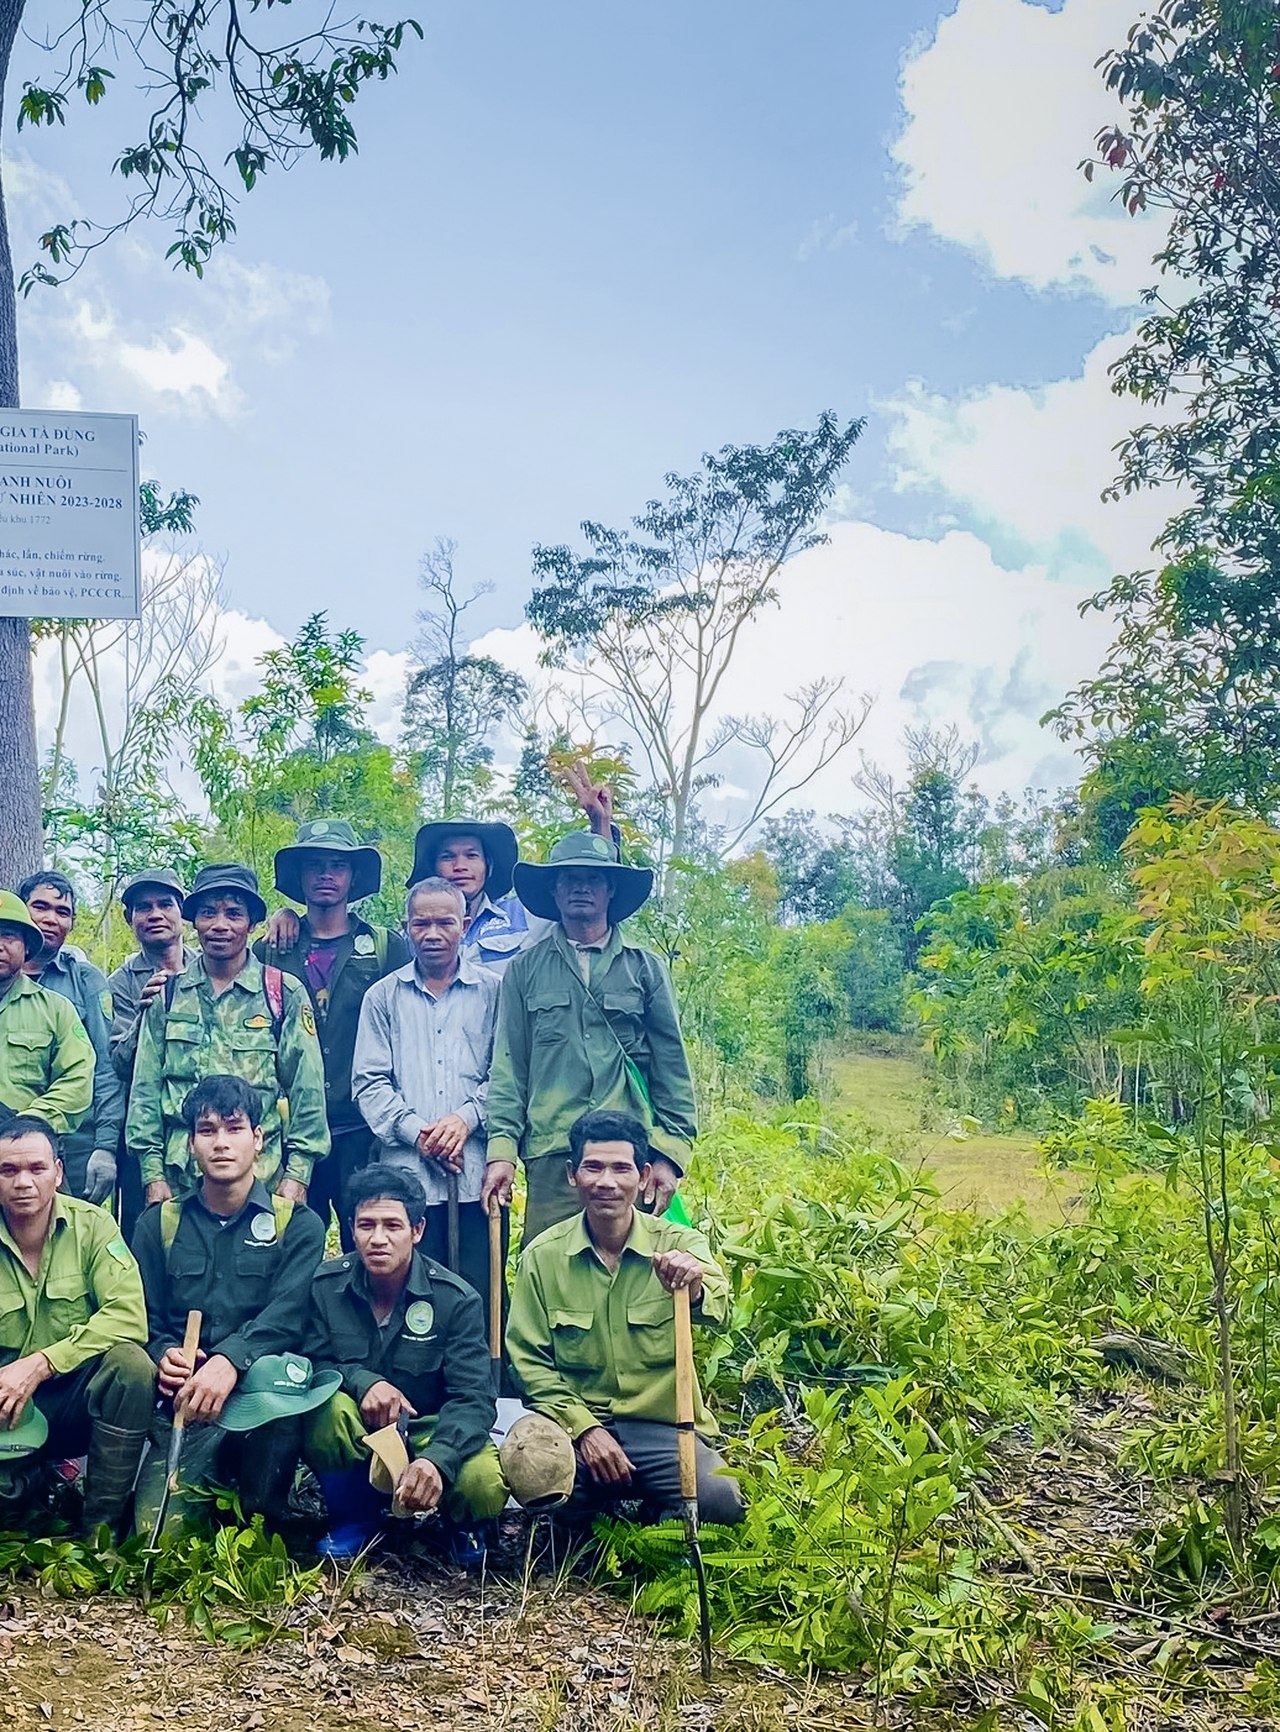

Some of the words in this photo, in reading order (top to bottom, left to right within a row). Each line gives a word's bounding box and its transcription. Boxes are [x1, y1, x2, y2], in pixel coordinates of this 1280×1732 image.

[0, 426, 26, 438] GIA
[30, 425, 49, 439] TÀ
[54, 427, 95, 441] ĐÙNG
[45, 444, 79, 457] Park)
[36, 475, 72, 489] NUÔI
[10, 492, 57, 505] NHIÊN
[61, 496, 122, 509] 2023-2028
[11, 514, 26, 523] khu
[30, 515, 51, 524] 1772
[45, 548, 74, 560] chiếm
[7, 569, 26, 577] súc,
[30, 568, 45, 580] vật
[48, 568, 71, 578] nuôi
[74, 570, 92, 579] vào
[1, 586, 24, 597] định
[28, 584, 38, 595] về
